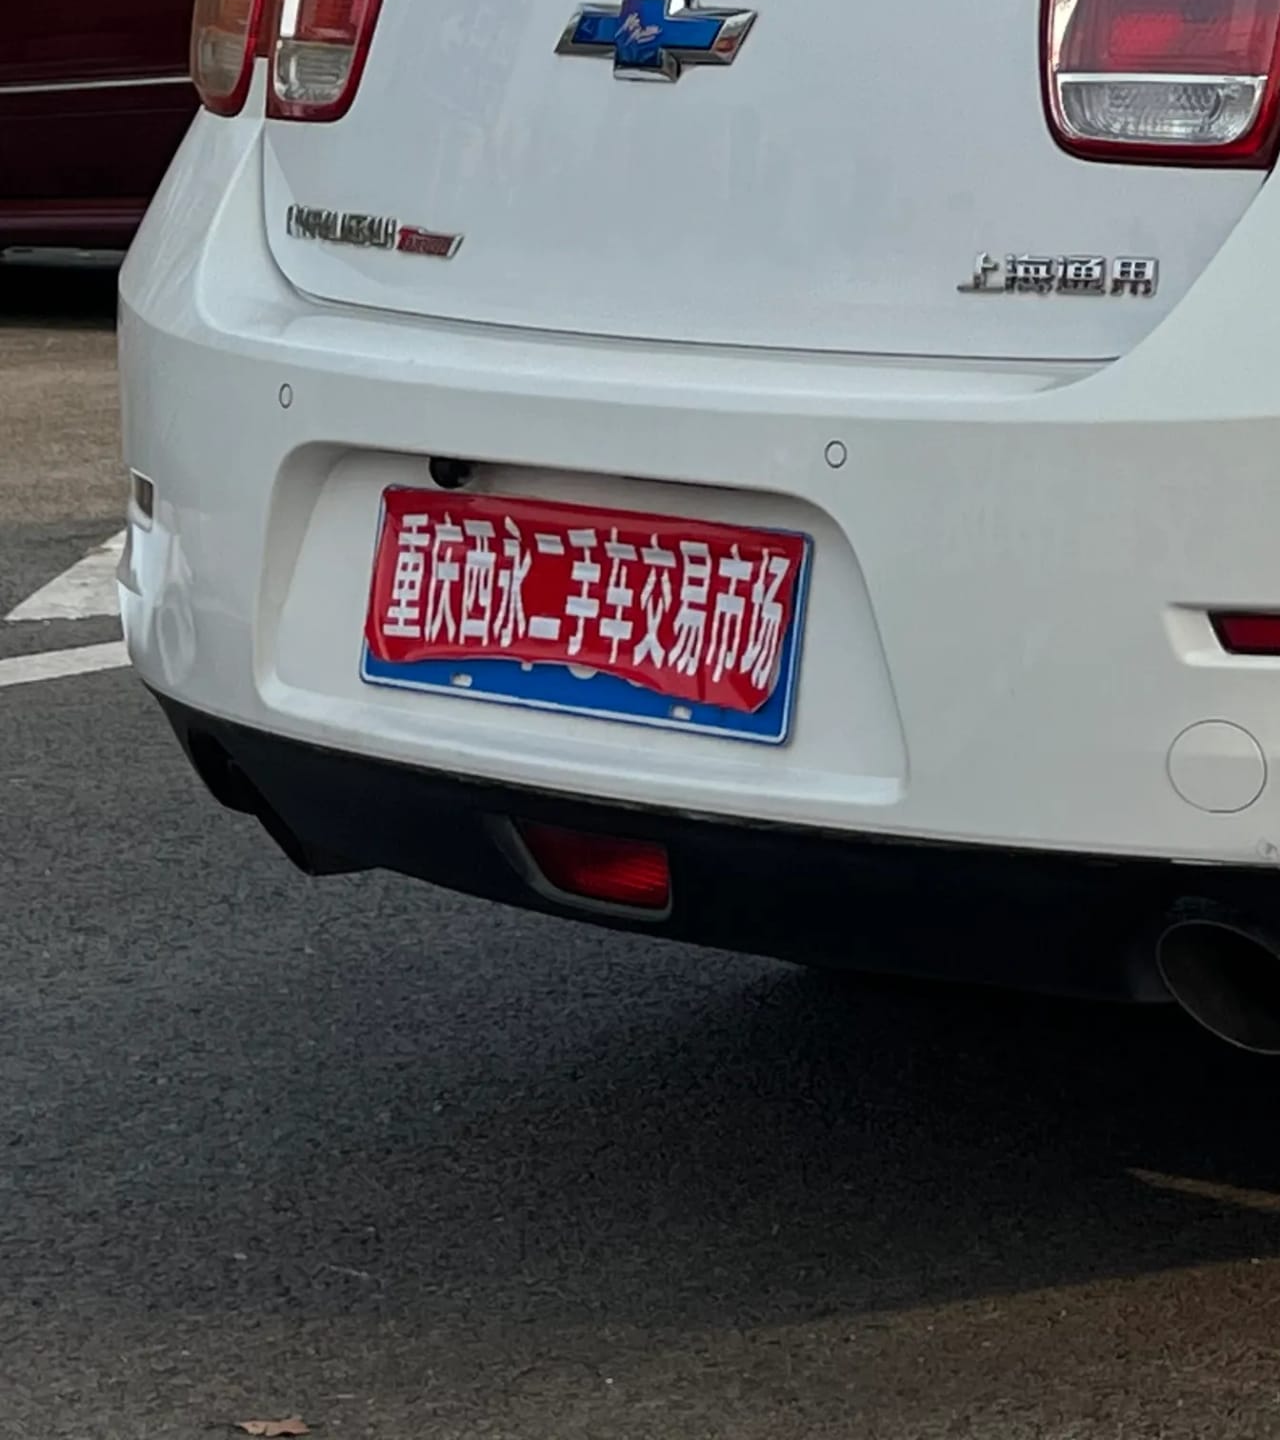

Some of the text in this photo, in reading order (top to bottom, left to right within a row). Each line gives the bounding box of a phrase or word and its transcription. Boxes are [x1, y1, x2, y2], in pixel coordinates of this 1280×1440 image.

[956, 251, 1159, 297] 上海通用
[382, 511, 790, 690] 重庆西永二手车交易市场
